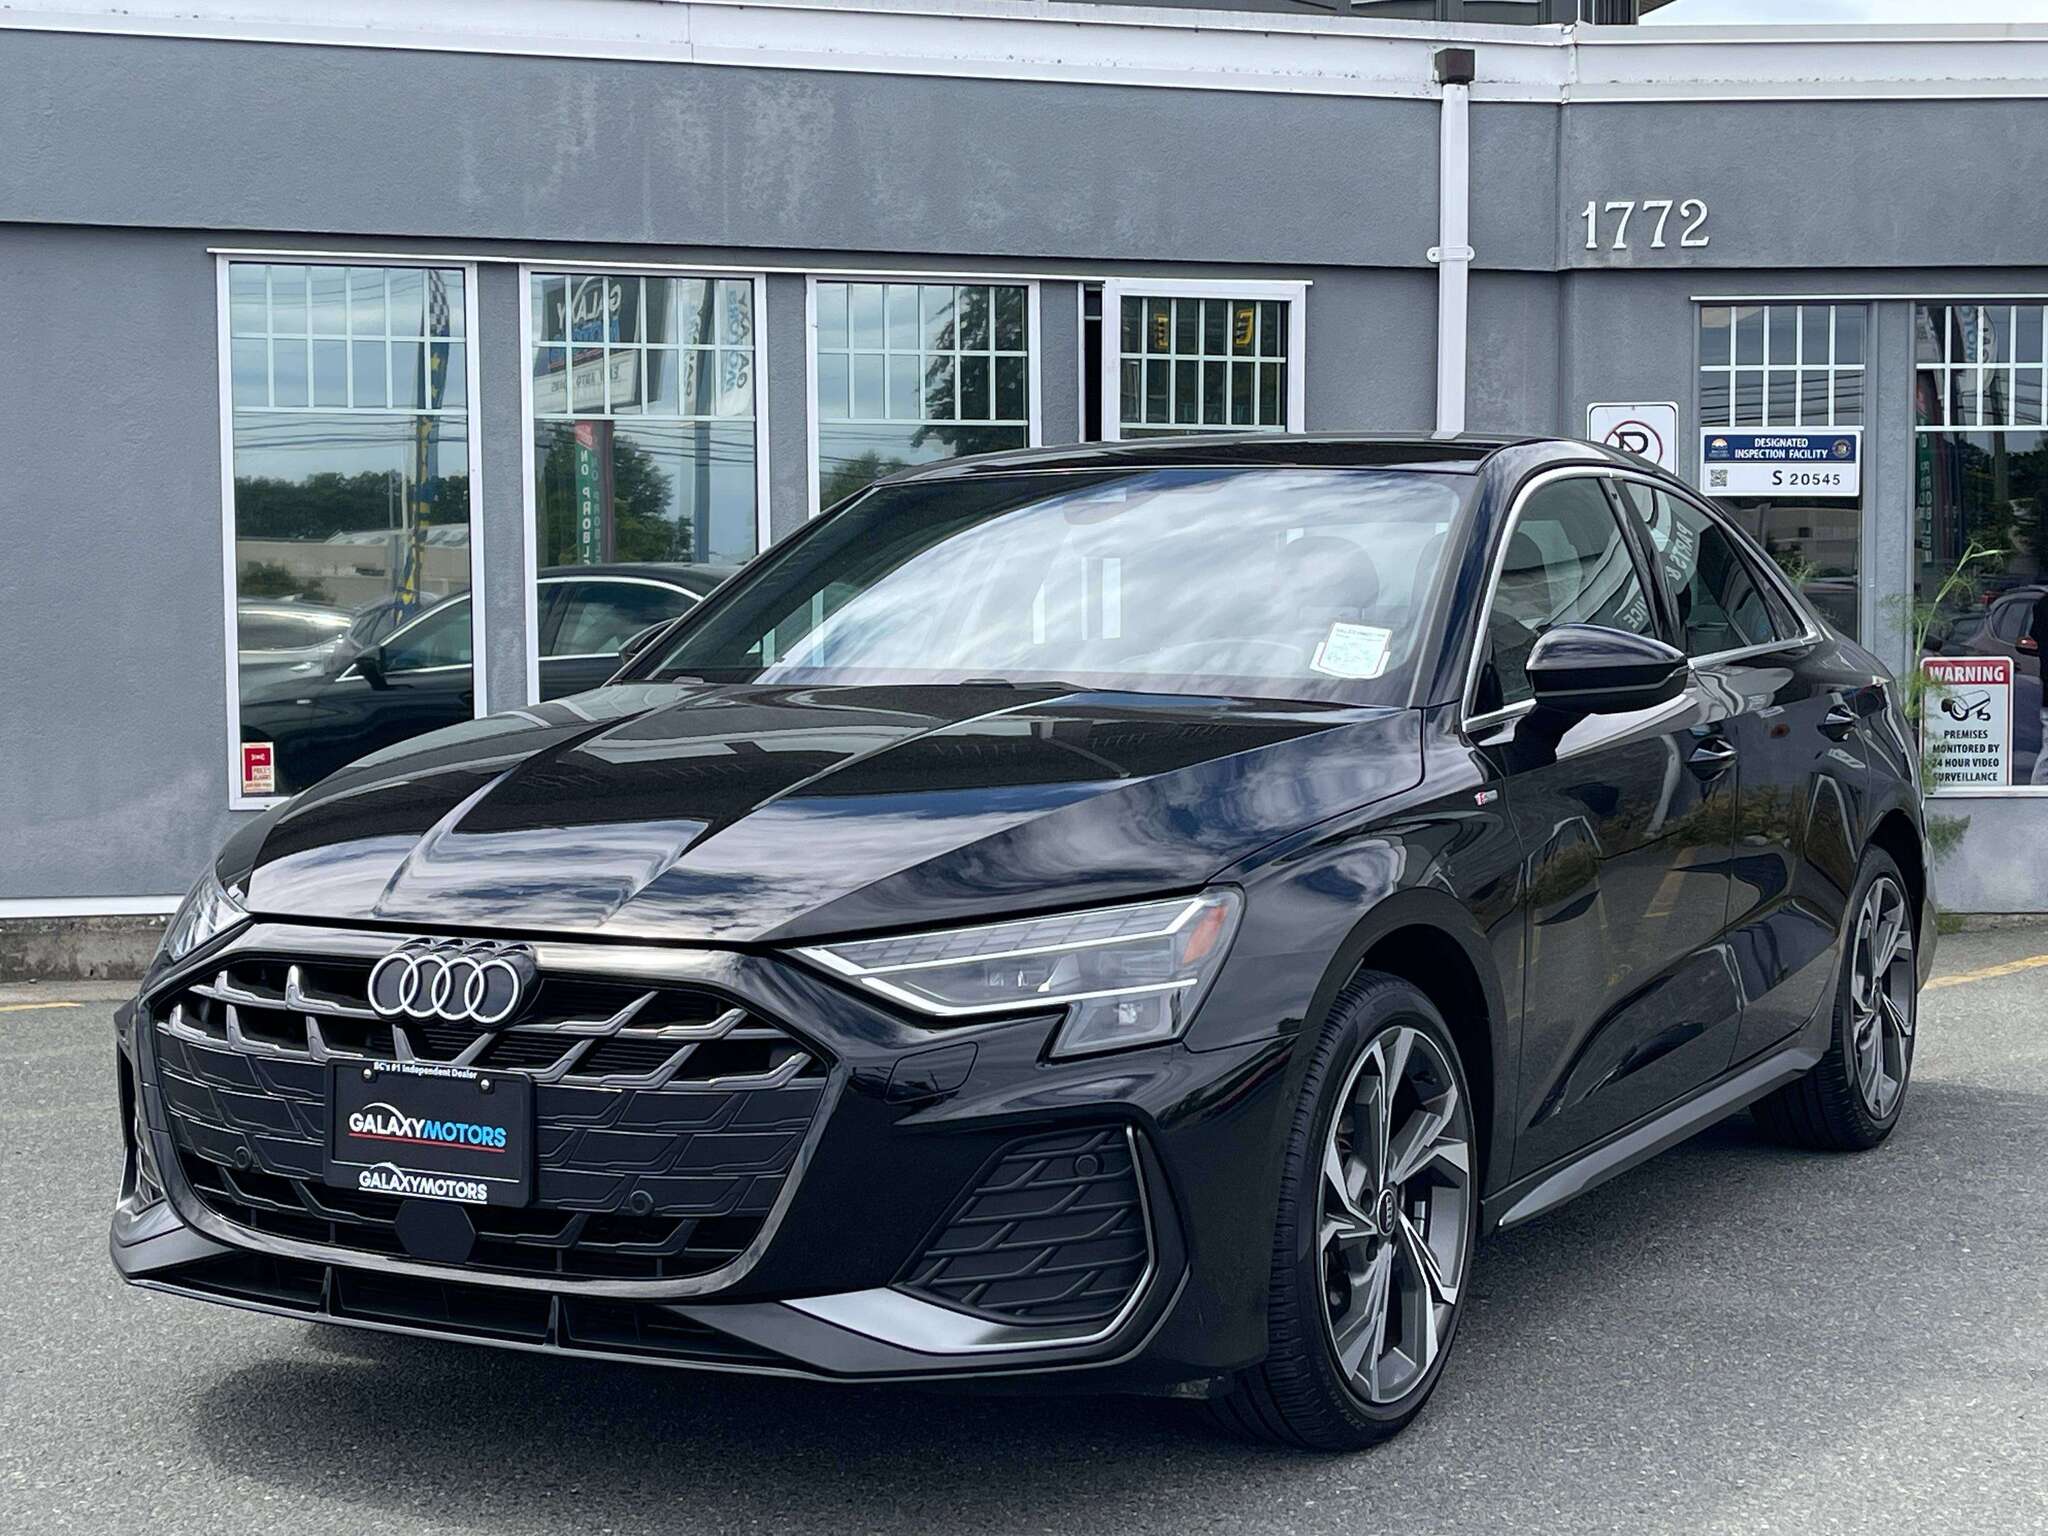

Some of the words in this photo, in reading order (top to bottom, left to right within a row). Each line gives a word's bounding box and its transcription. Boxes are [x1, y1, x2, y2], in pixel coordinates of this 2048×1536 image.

[1581, 198, 1711, 250] 1772
[1754, 437, 1809, 448] DESIGNATED
[1734, 449, 1786, 459] INSPECTION
[1789, 449, 1828, 459] FACILITY
[1772, 470, 1783, 486] S
[1789, 473, 1841, 486] 20545
[1928, 665, 2005, 683] WARNING
[1943, 729, 1989, 739] PREMISES
[1932, 743, 1986, 753] MONITORED
[1988, 743, 2001, 753] BY
[1945, 758, 1971, 768] HOUR
[1972, 758, 2000, 768] VIDEO
[1932, 772, 1998, 782] SURVEILLANCE
[402, 1064, 451, 1076] Independent
[451, 1069, 478, 1079] Dealer
